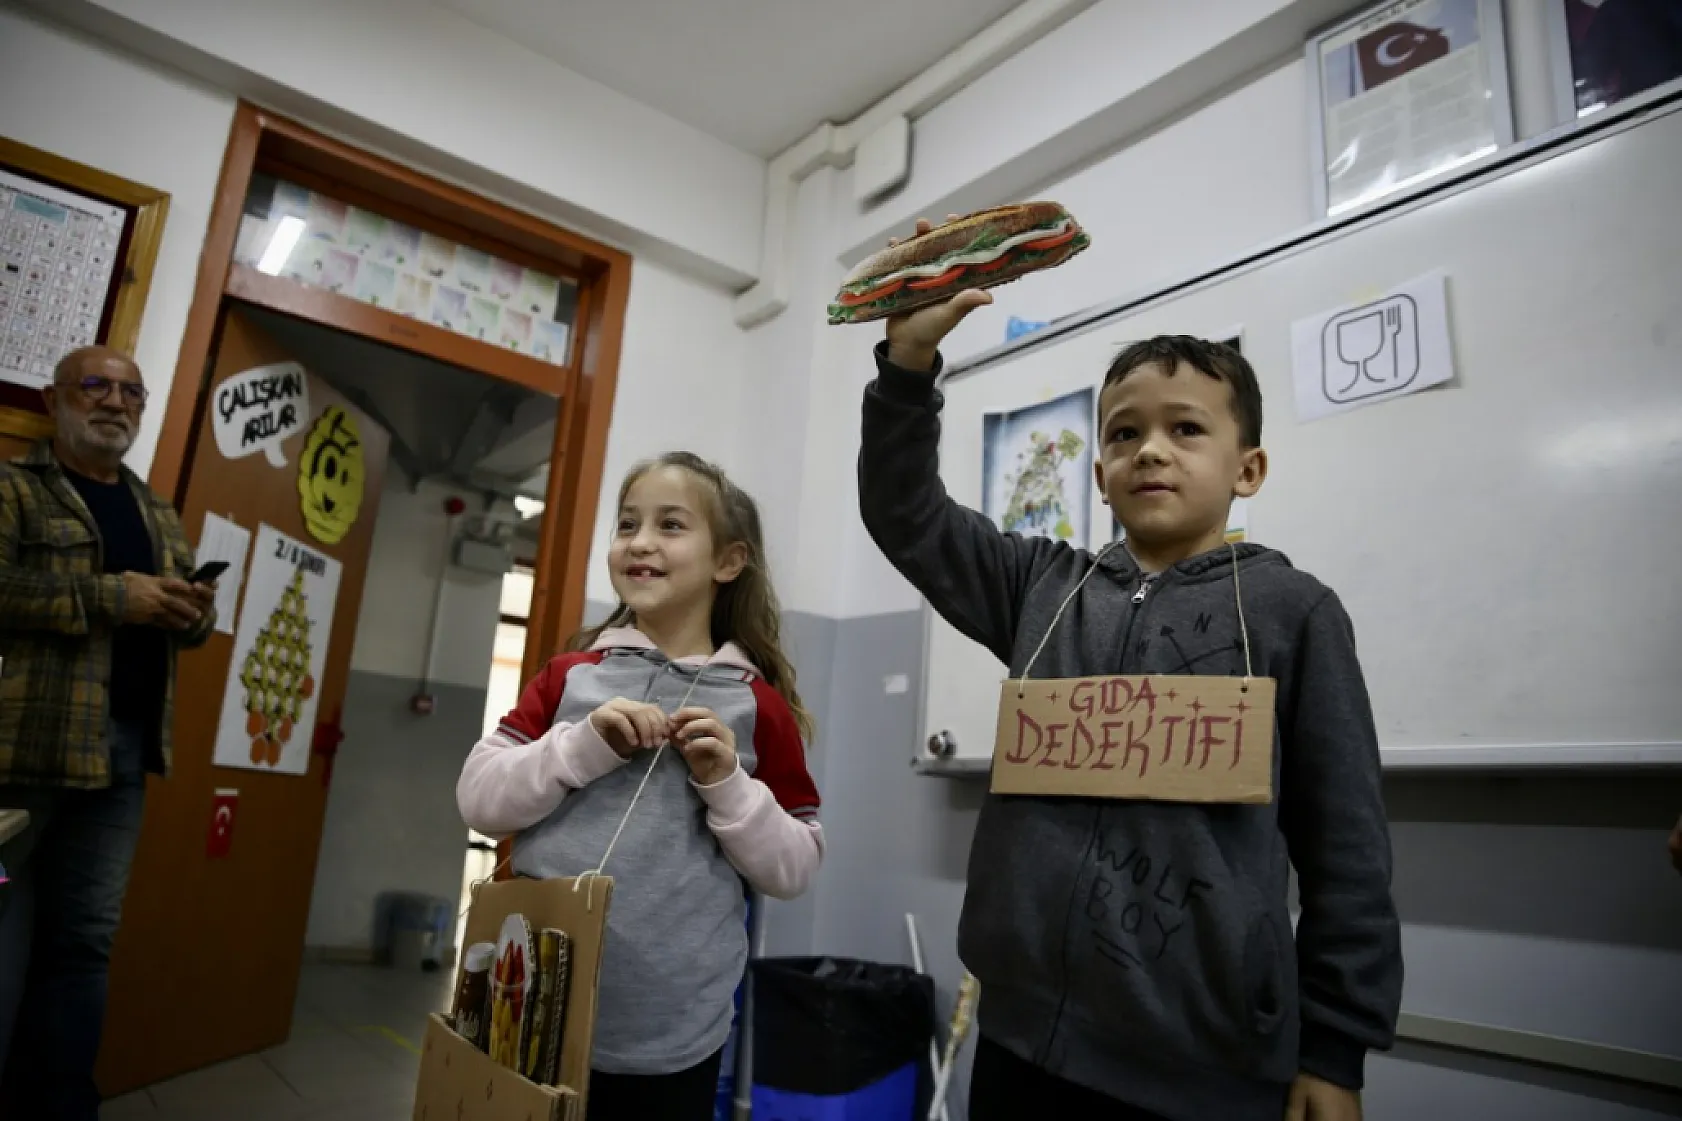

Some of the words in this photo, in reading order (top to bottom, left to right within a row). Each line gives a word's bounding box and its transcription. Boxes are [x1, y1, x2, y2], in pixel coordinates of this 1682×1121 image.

[1068, 677, 1157, 719] GIDA
[1096, 832, 1214, 910] WOLF
[1086, 876, 1184, 960] BOY
